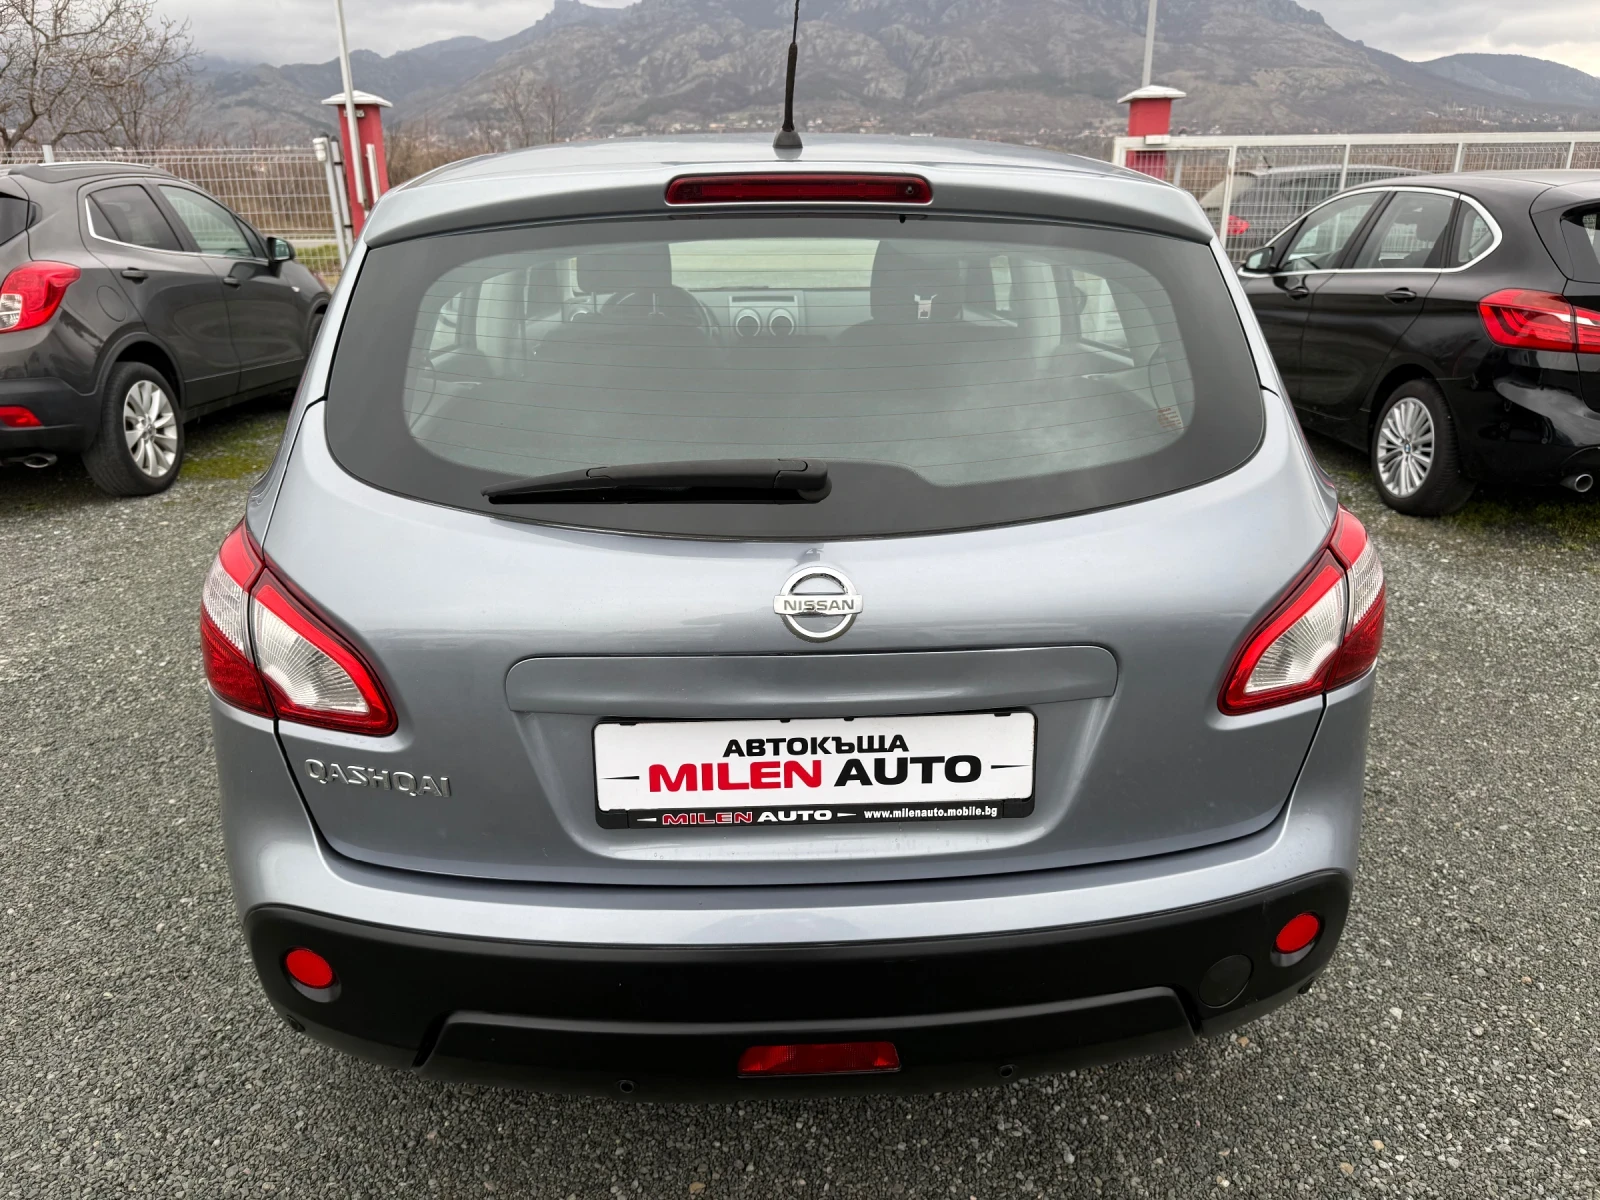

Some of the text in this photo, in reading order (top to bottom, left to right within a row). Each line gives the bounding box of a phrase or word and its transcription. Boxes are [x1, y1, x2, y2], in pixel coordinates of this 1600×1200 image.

[783, 599, 855, 611] NISSAN
[722, 734, 909, 757] АВТОКЪЩА
[304, 758, 451, 798] QASHQAI
[648, 755, 982, 792] MILEN AUTO
[662, 806, 998, 825] MILEN AUTO www.milenauto.mobile.bg
